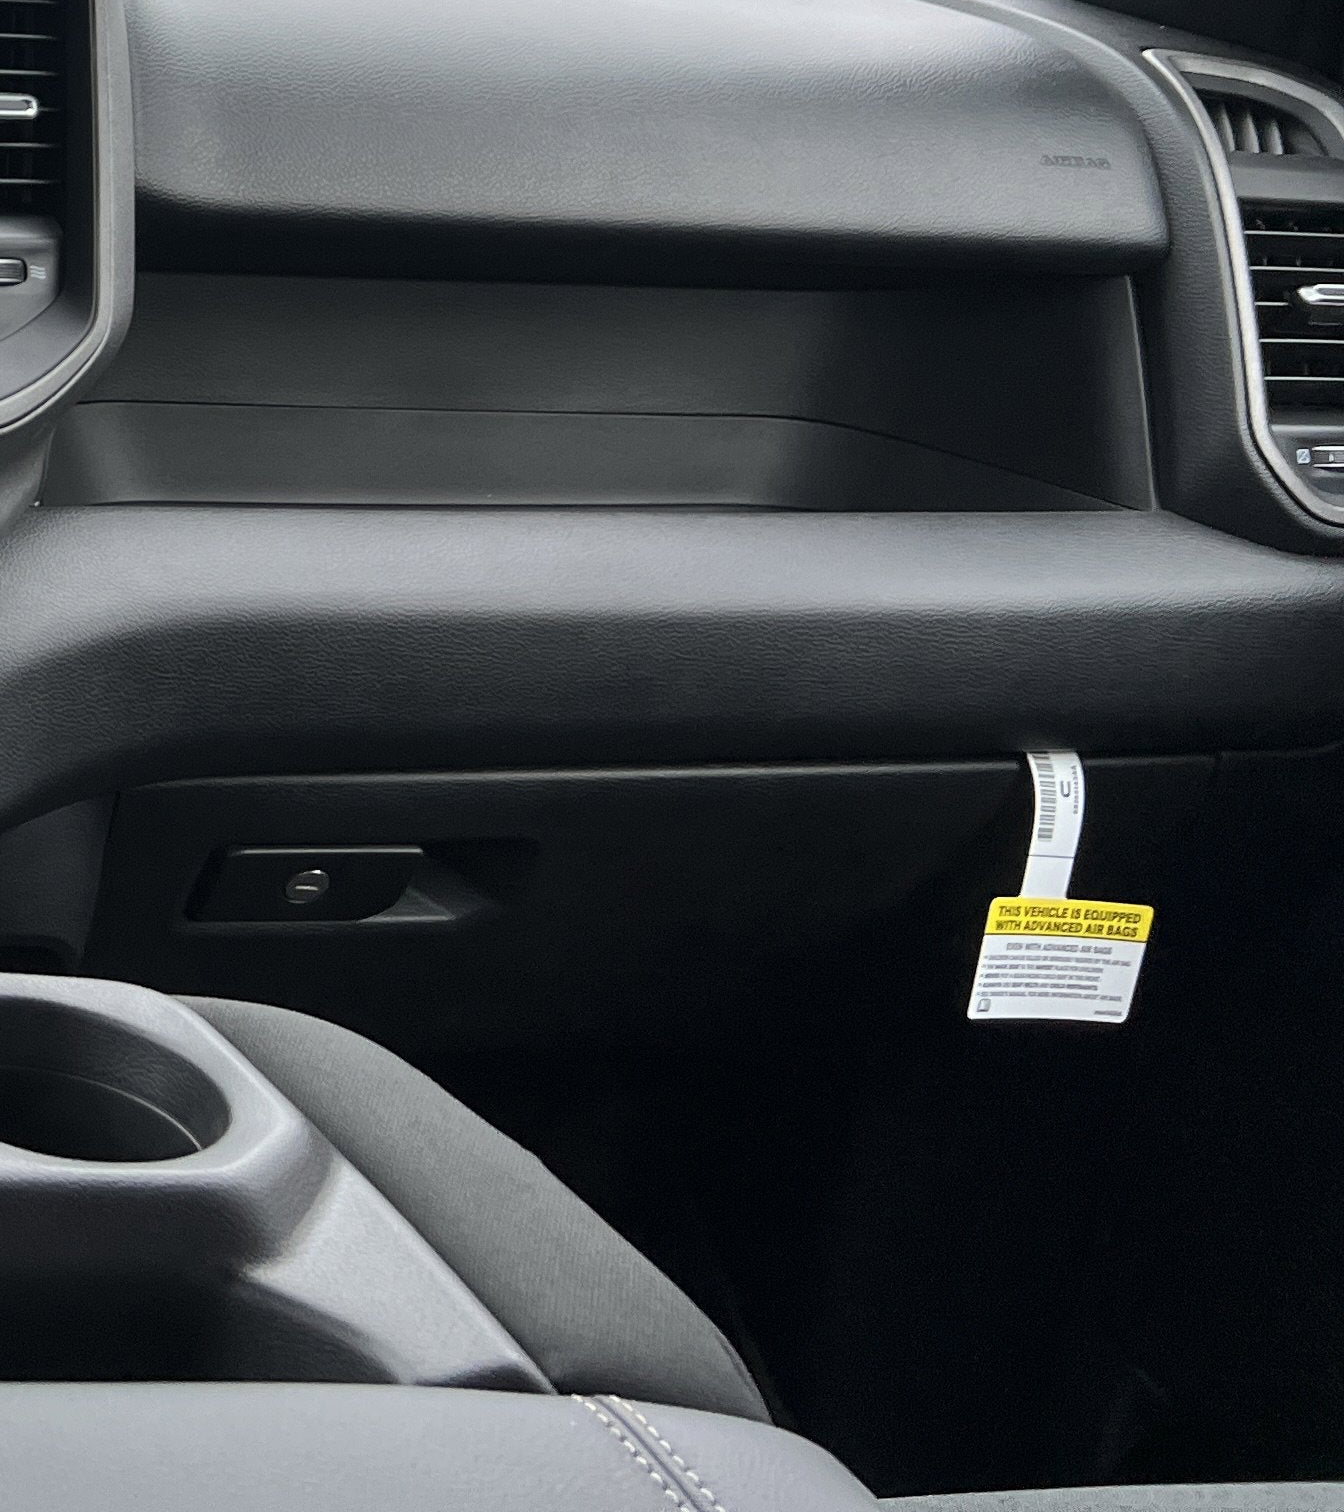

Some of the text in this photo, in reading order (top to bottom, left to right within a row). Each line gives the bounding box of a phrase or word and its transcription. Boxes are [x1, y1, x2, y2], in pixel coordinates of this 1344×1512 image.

[998, 905, 1141, 924] THIS VEHICLE IS EQUIPPED
[995, 920, 1139, 937] WITH ADVANCED AIR BAGS
